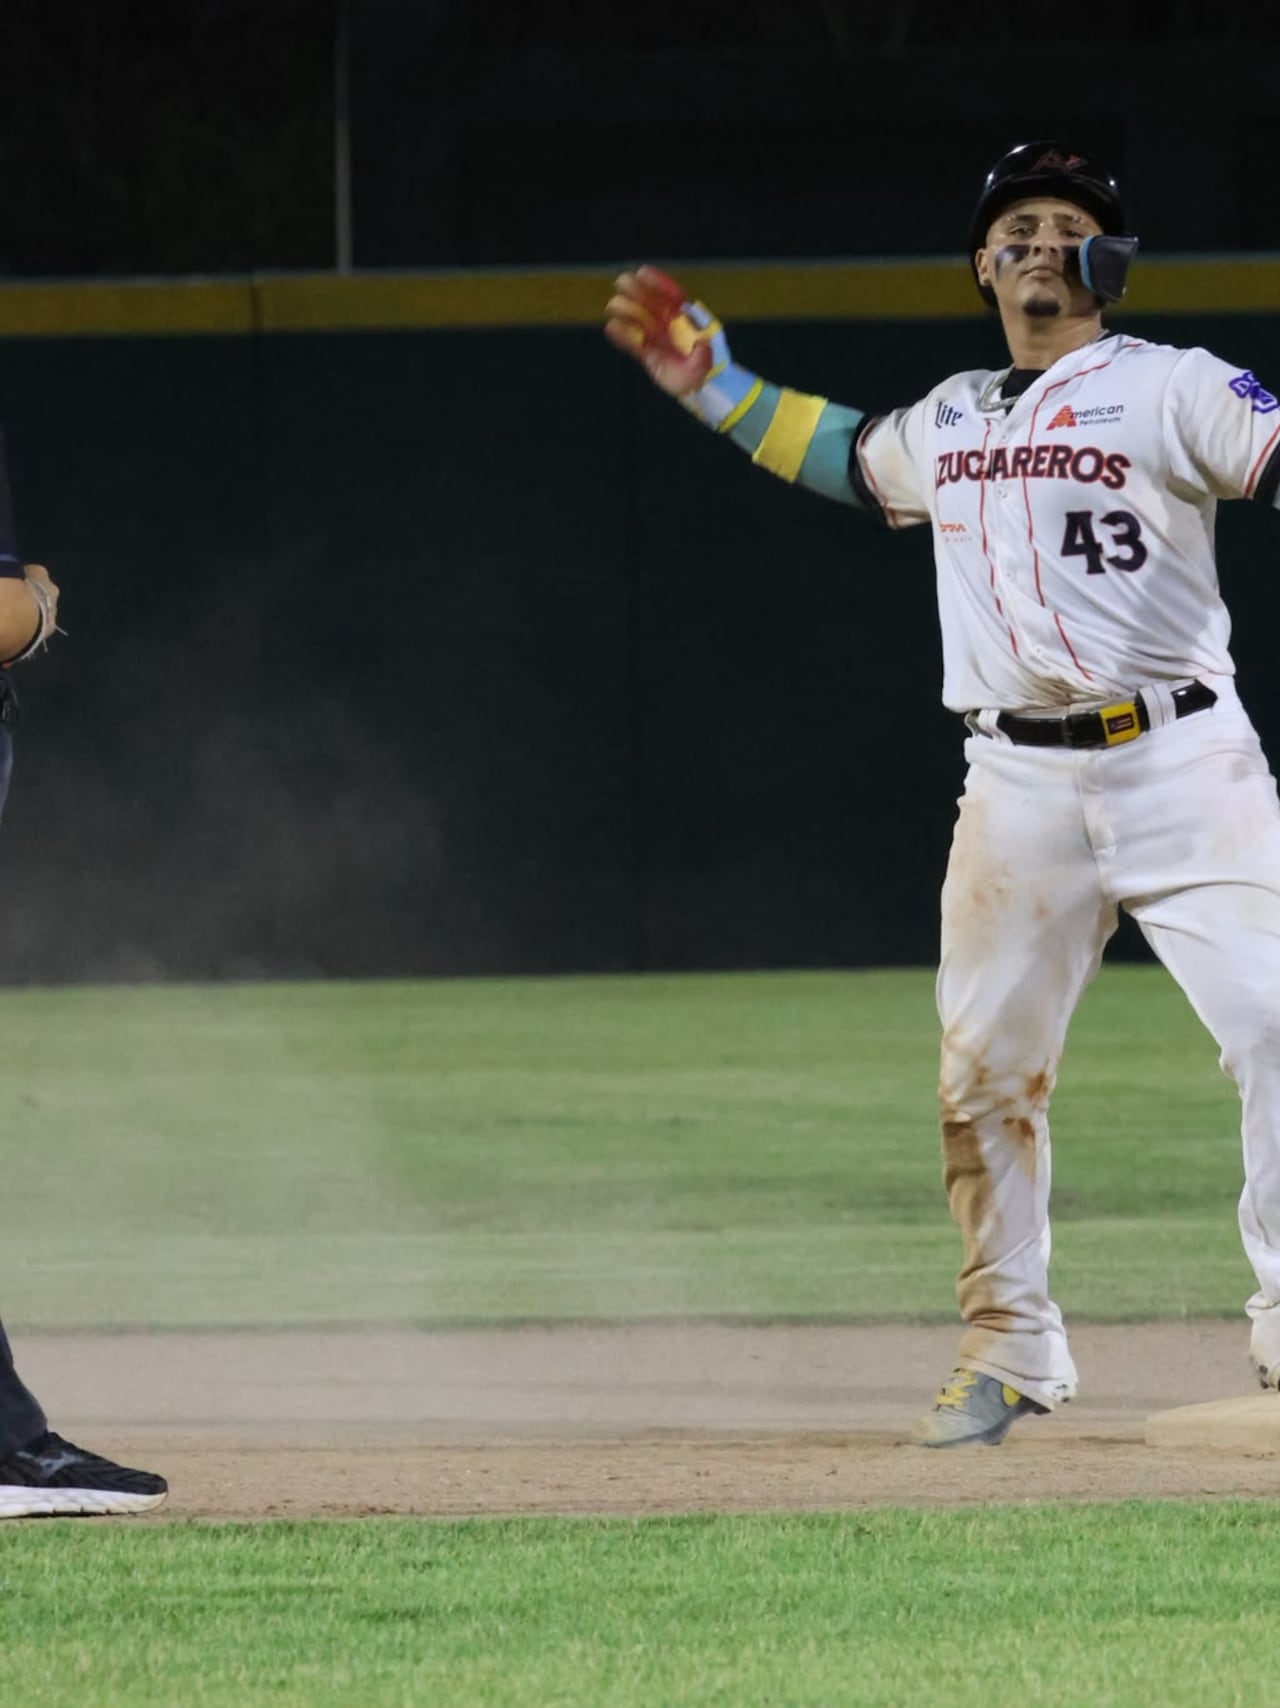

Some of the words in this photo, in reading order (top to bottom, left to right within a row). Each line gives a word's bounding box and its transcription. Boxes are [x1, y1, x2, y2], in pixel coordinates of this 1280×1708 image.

[935, 401, 963, 429] Lite
[1046, 404, 1125, 431] American
[935, 444, 1132, 489] ZUCAREROS
[1060, 510, 1149, 575] 43
